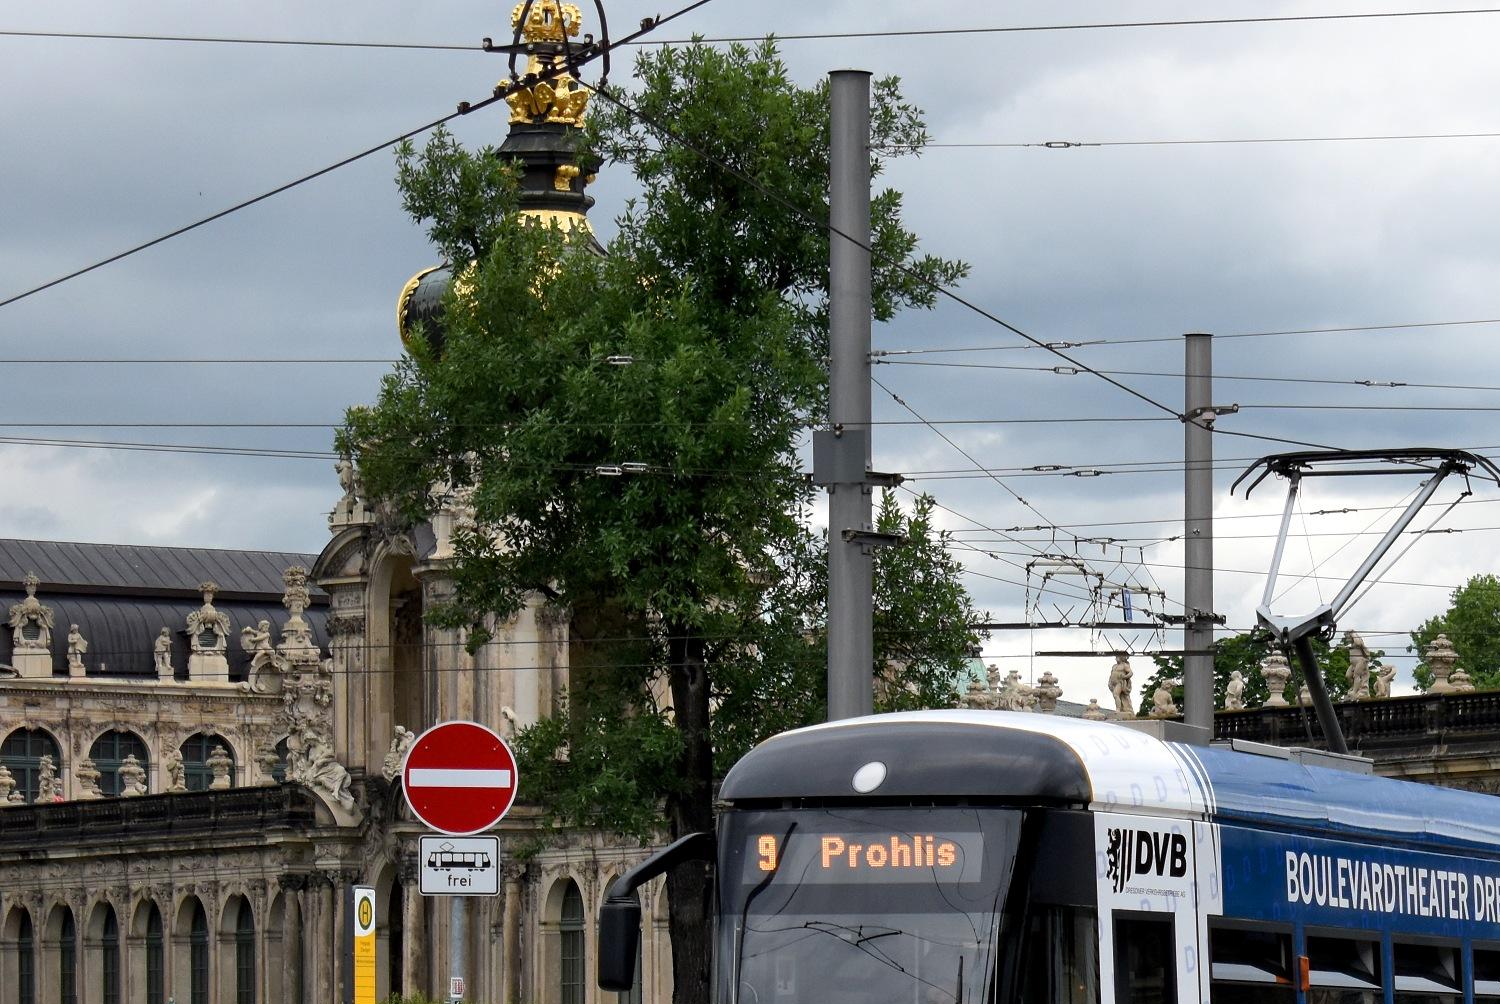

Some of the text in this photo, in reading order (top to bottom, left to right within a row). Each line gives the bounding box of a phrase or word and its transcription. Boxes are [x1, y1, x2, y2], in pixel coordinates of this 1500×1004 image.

[758, 835, 957, 871] 9 Prohlis
[1135, 830, 1187, 878] DVB
[447, 874, 472, 887] frei
[1285, 850, 1470, 920] BOULEVARDTHEATER
